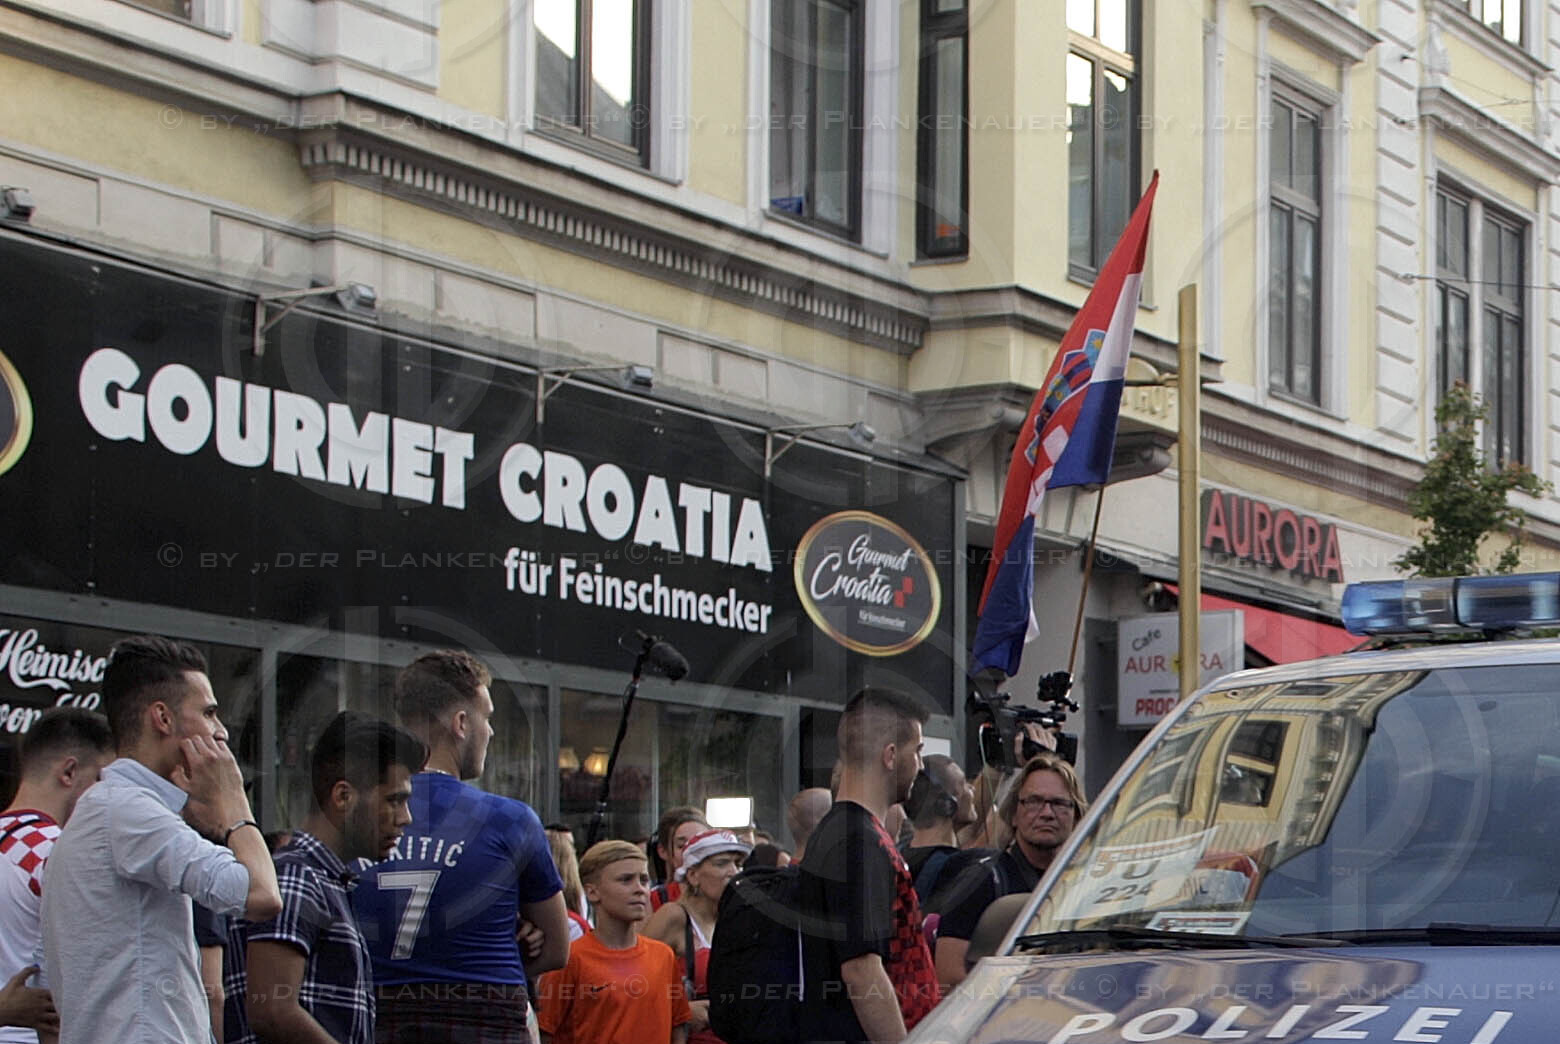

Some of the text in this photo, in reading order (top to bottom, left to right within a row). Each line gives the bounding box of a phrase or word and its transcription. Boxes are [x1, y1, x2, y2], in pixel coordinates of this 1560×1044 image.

[79, 347, 773, 573] GOURMET CROATIA
[810, 553, 894, 605] Croatia
[1204, 488, 1345, 584] AURORA
[504, 547, 773, 634] für Feinschmecker
[0, 628, 116, 691] Heimisc
[377, 869, 442, 960] 7
